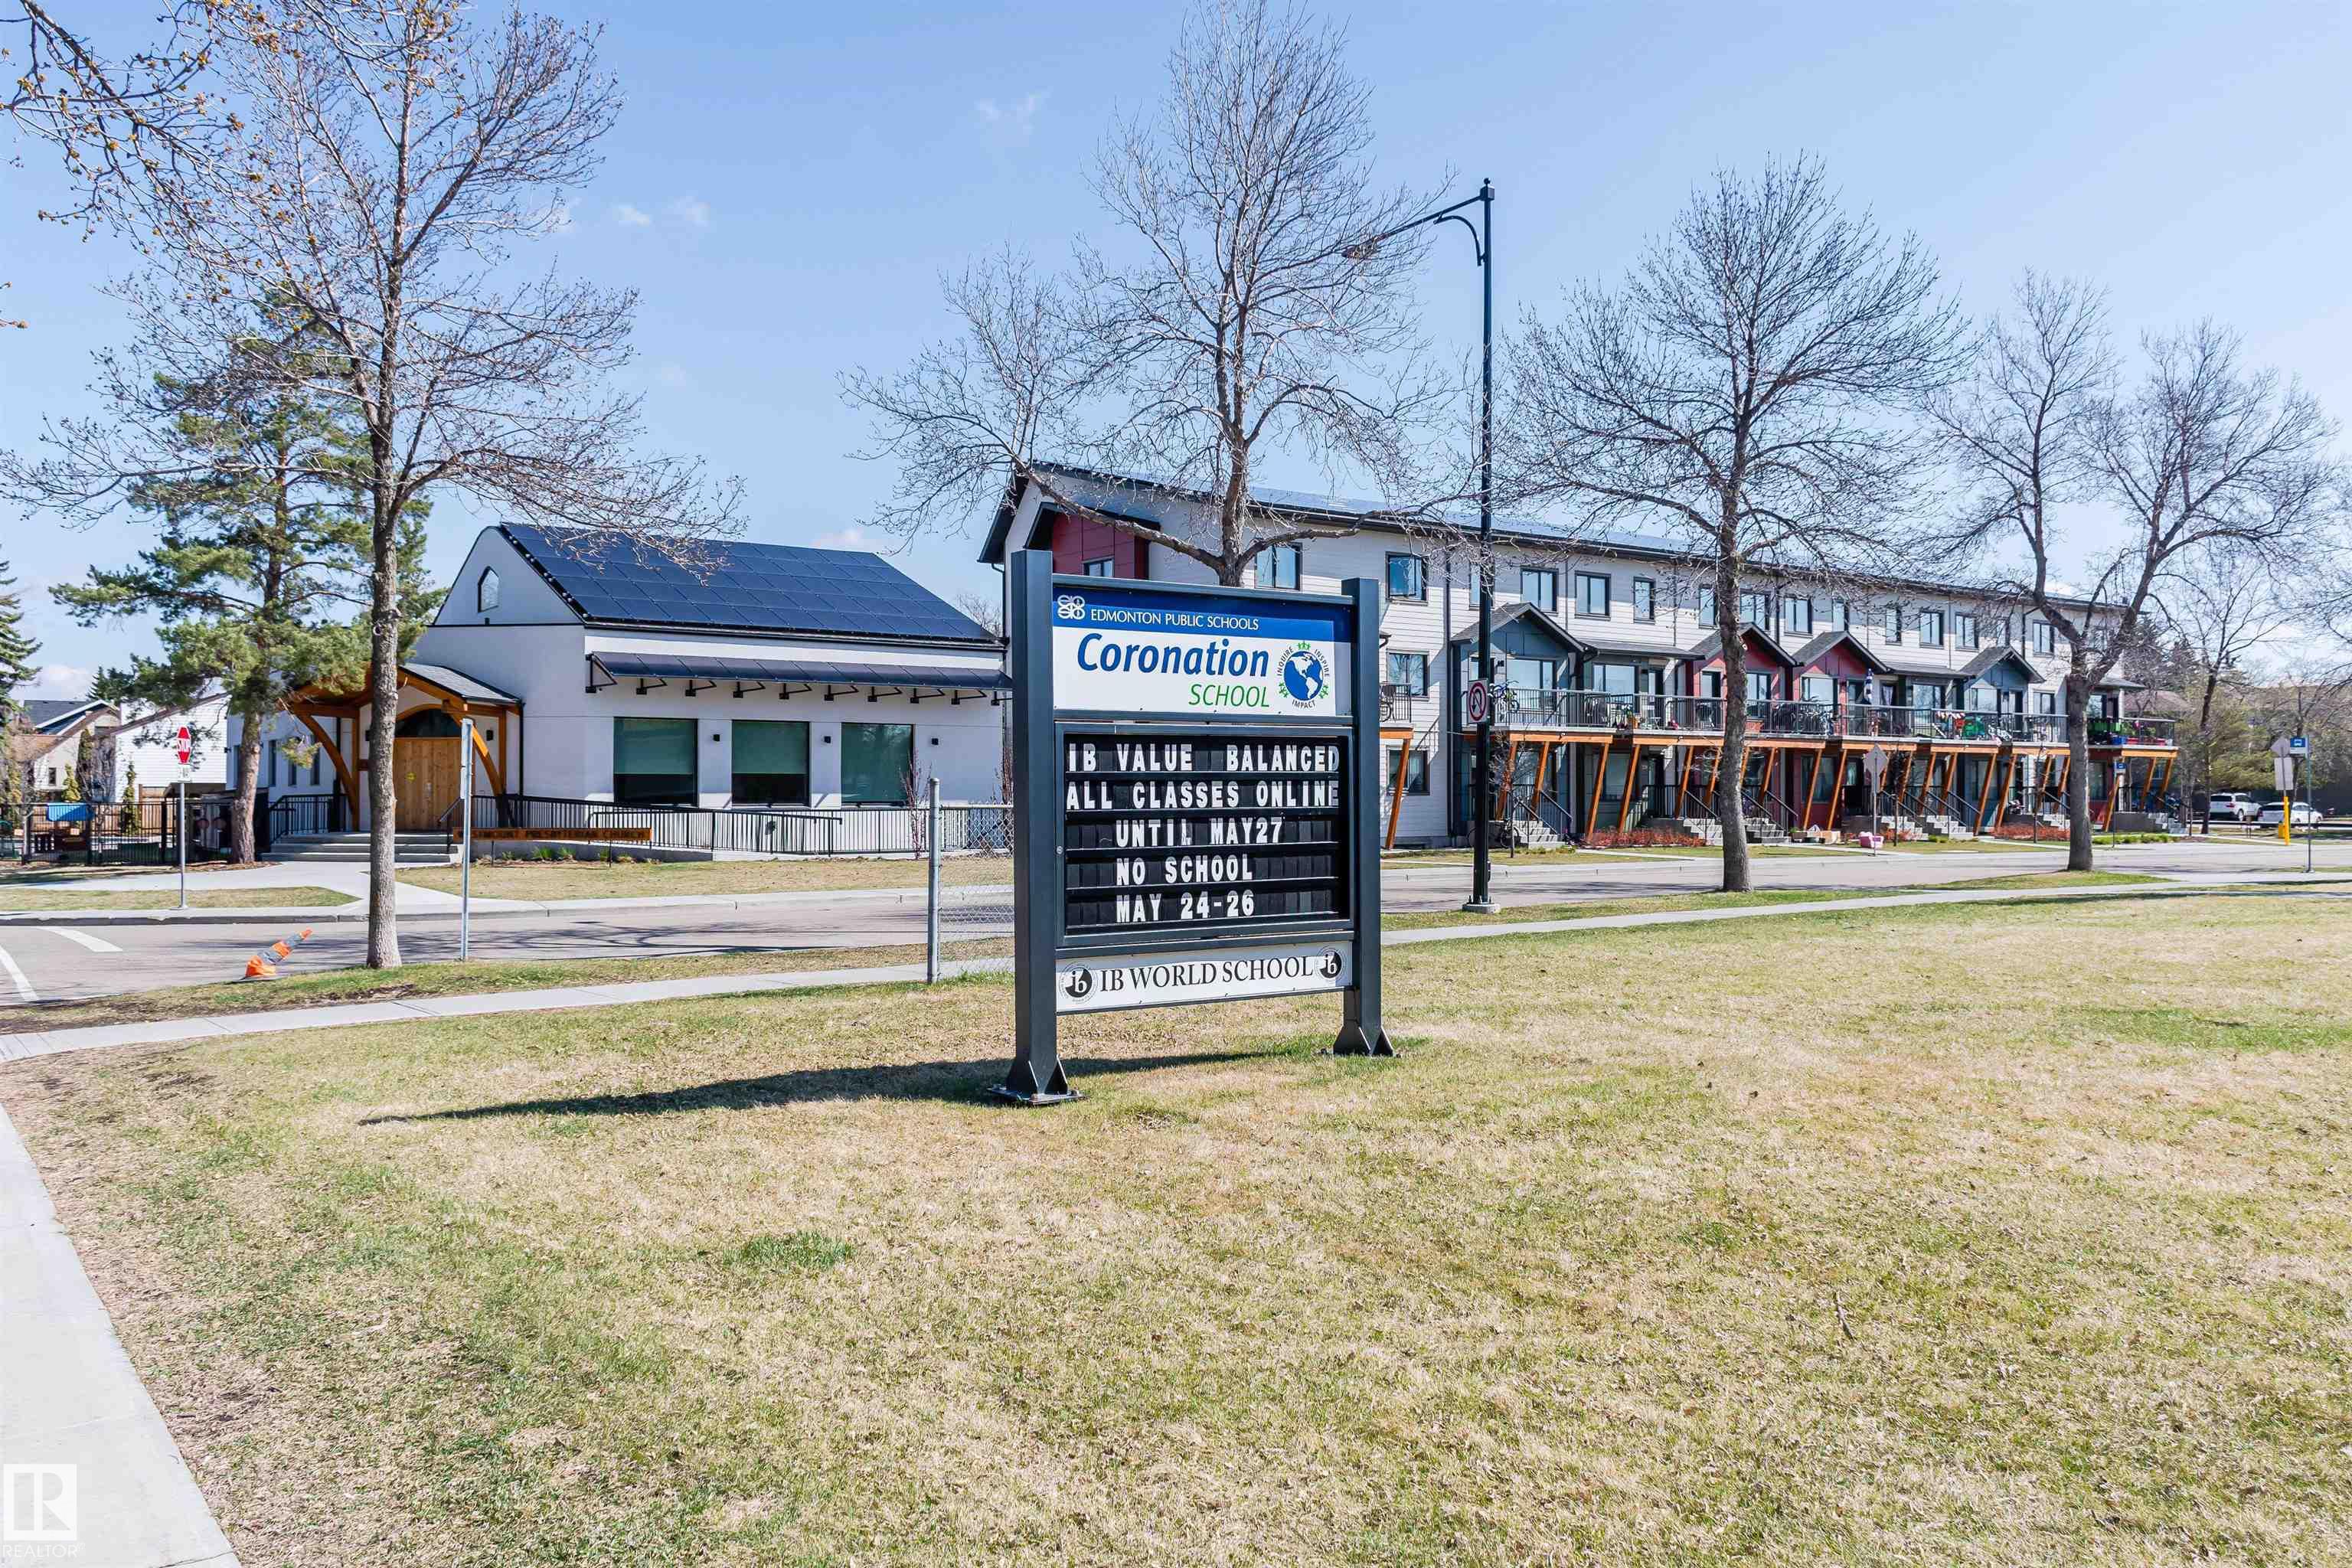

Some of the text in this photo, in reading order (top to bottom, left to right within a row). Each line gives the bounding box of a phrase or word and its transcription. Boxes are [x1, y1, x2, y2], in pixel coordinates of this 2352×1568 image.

[1091, 609, 1259, 631] EDMONTON PUBLIC SCHOOLS
[1078, 632, 1269, 677] Coronation
[1277, 646, 1294, 676] INQUIRE
[1315, 649, 1330, 677] INSPIRE
[1188, 683, 1269, 707] SCHOOL
[1292, 699, 1315, 709] IMPACT
[1069, 743, 1340, 772] IB VALUE BALANCED
[1066, 780, 1339, 809] ALL CLASSES ONLINE
[1116, 817, 1282, 847] UNTIL MAY27
[1116, 854, 1253, 885] NO SCHOOL
[1116, 890, 1255, 923] MAY 24-26
[1100, 956, 1314, 991] IB WORLD SCHOOL
